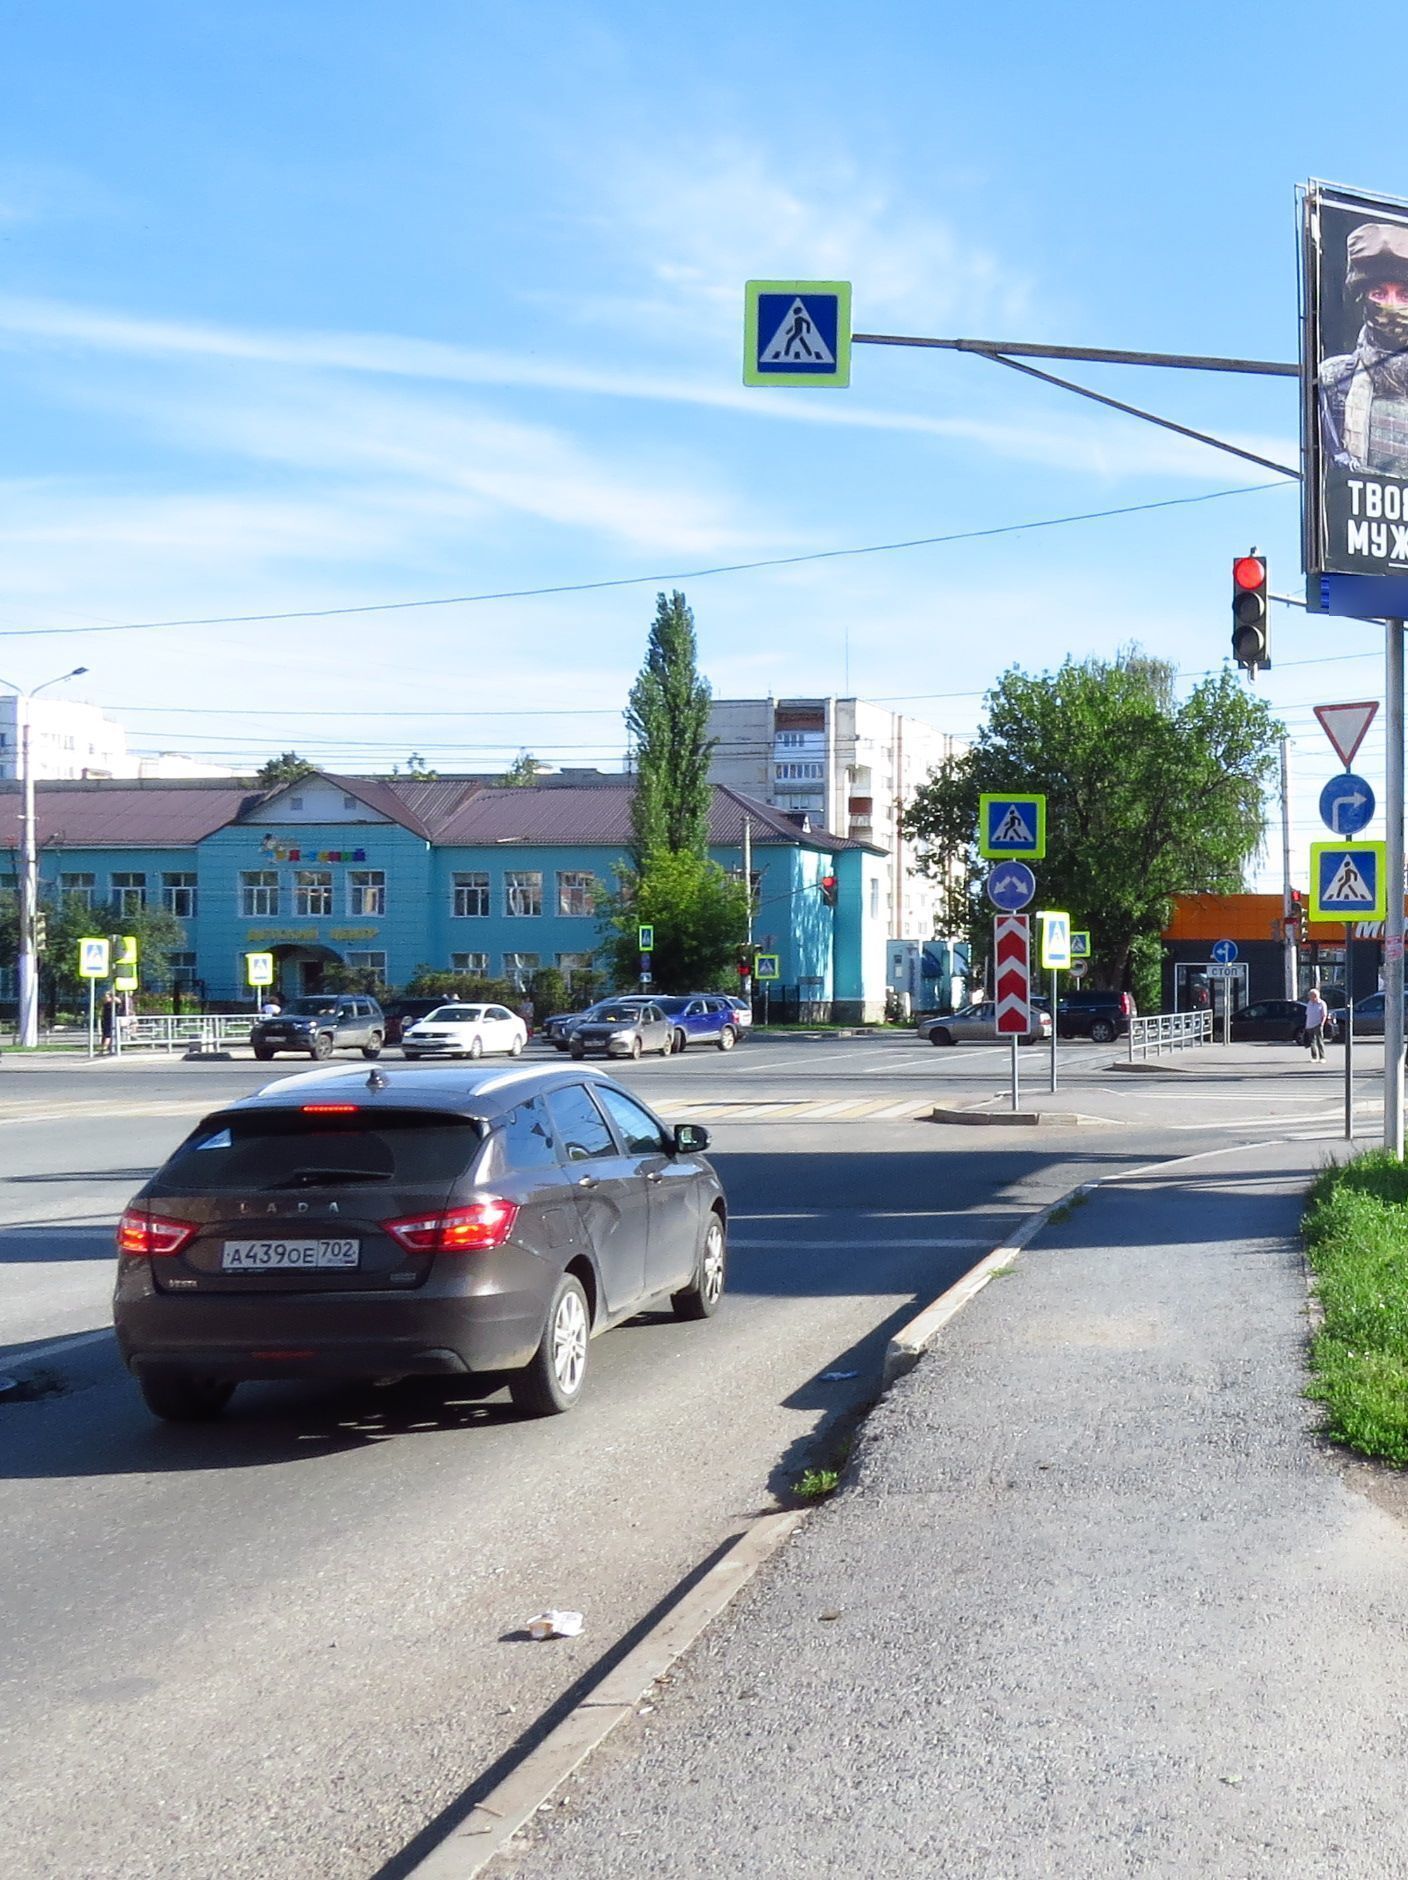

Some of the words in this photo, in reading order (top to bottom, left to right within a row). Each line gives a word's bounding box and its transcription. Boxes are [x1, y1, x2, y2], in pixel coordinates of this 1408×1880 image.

[1211, 967, 1238, 976] СТОП
[240, 1202, 340, 1213] LADA
[321, 1241, 354, 1258] 702
